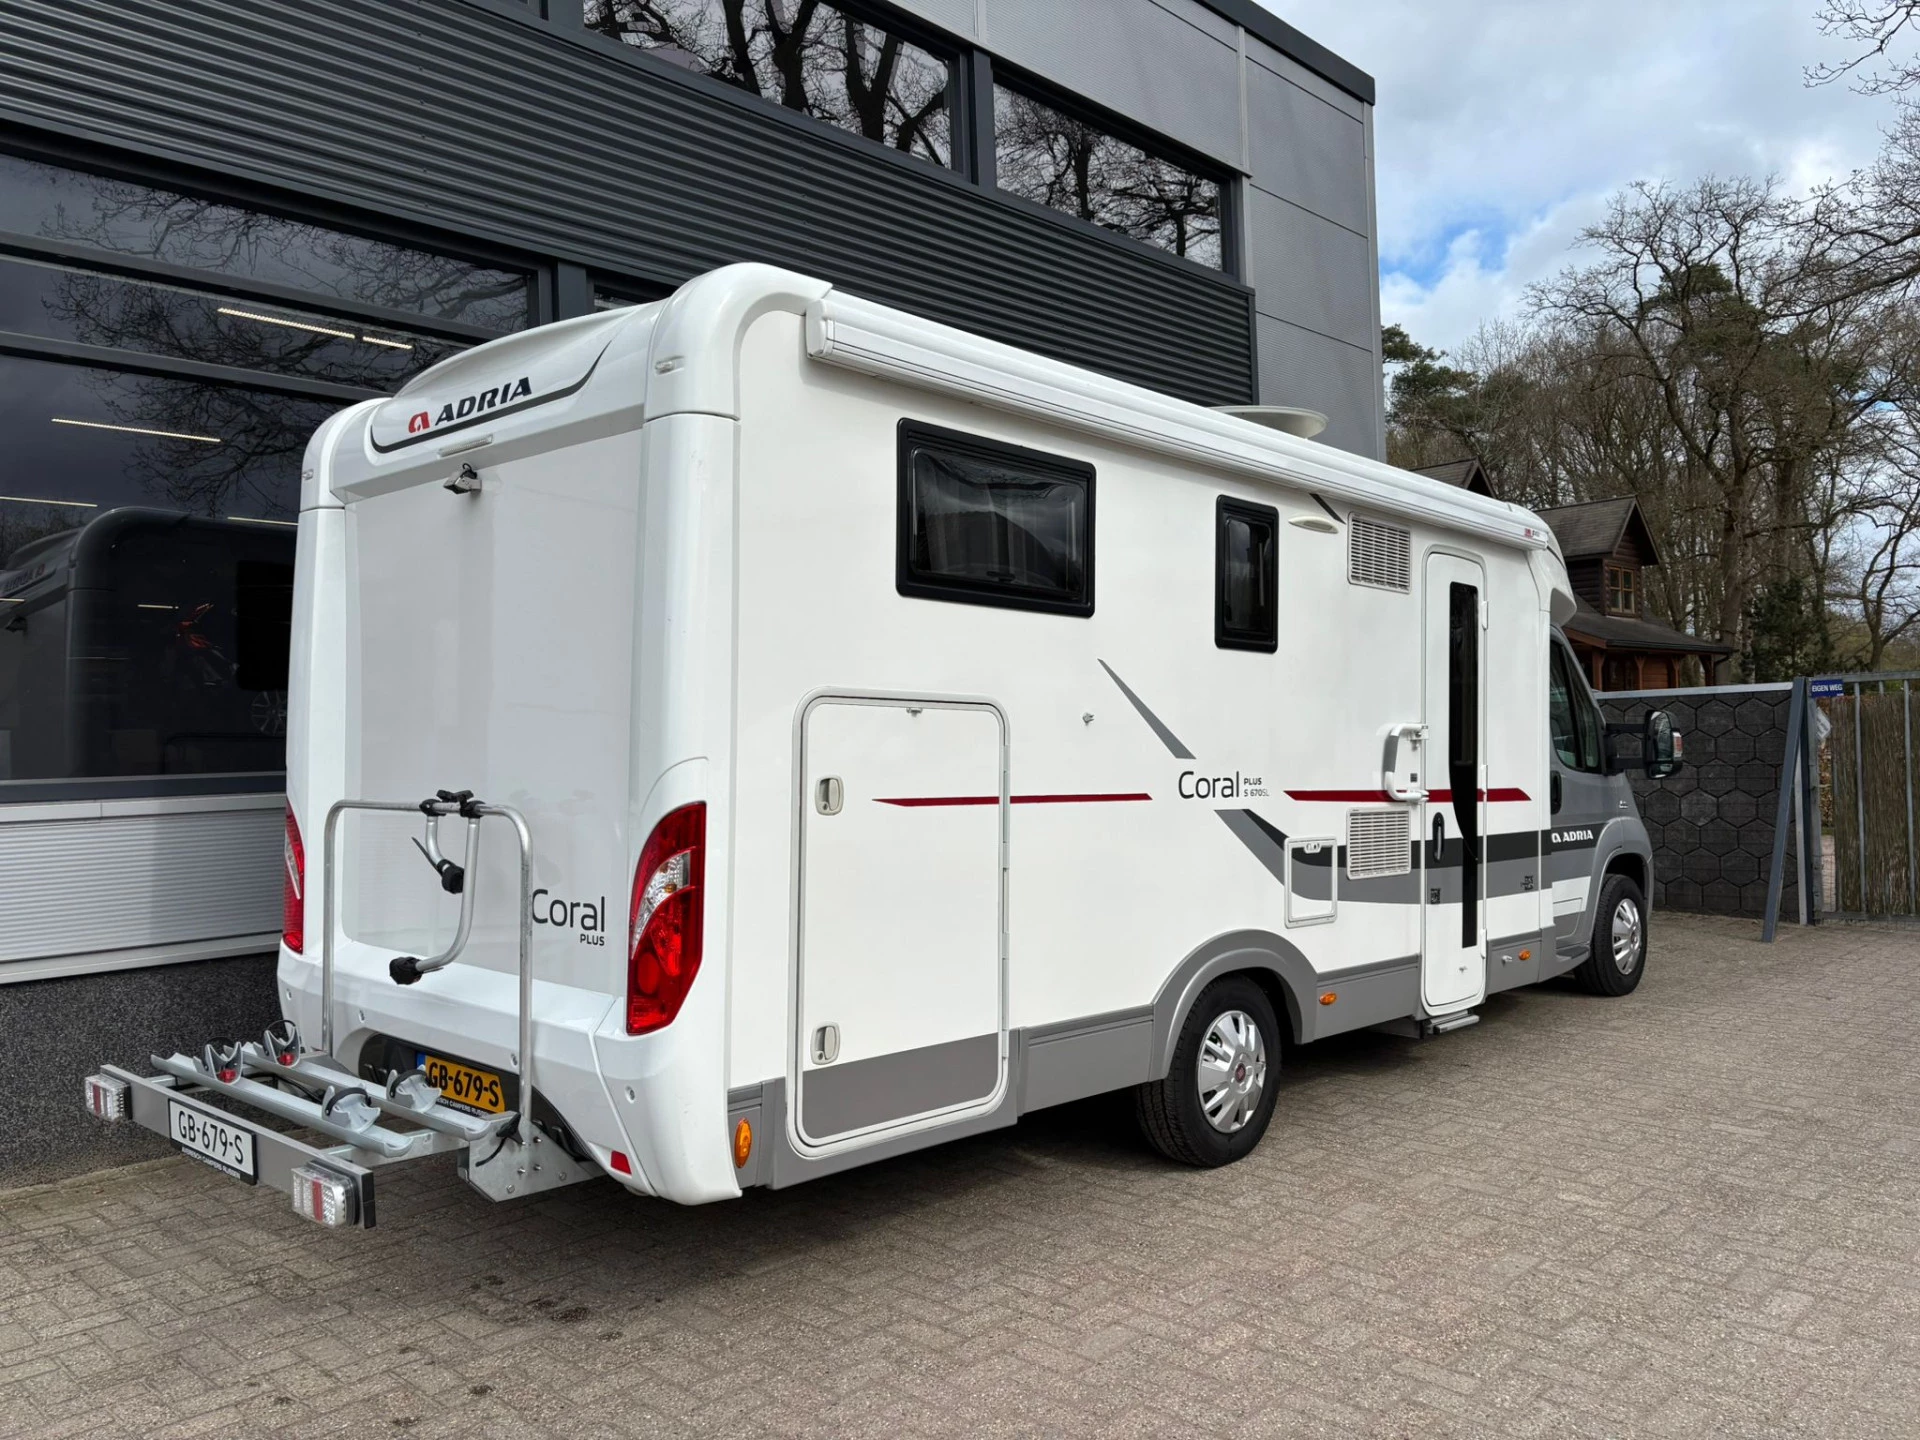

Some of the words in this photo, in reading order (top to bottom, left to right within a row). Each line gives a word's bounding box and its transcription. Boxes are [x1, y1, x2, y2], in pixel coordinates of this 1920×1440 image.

[435, 377, 532, 425] ADRIA
[1812, 684, 1828, 692] EIGEN
[1178, 771, 1239, 799] Coral
[1243, 777, 1262, 786] PLUS
[1563, 830, 1593, 842] ADRIA
[532, 888, 605, 932] Coral
[580, 933, 605, 946] PLUS
[428, 1061, 500, 1107] GB-679-S
[178, 1110, 244, 1165] GB-679-S
